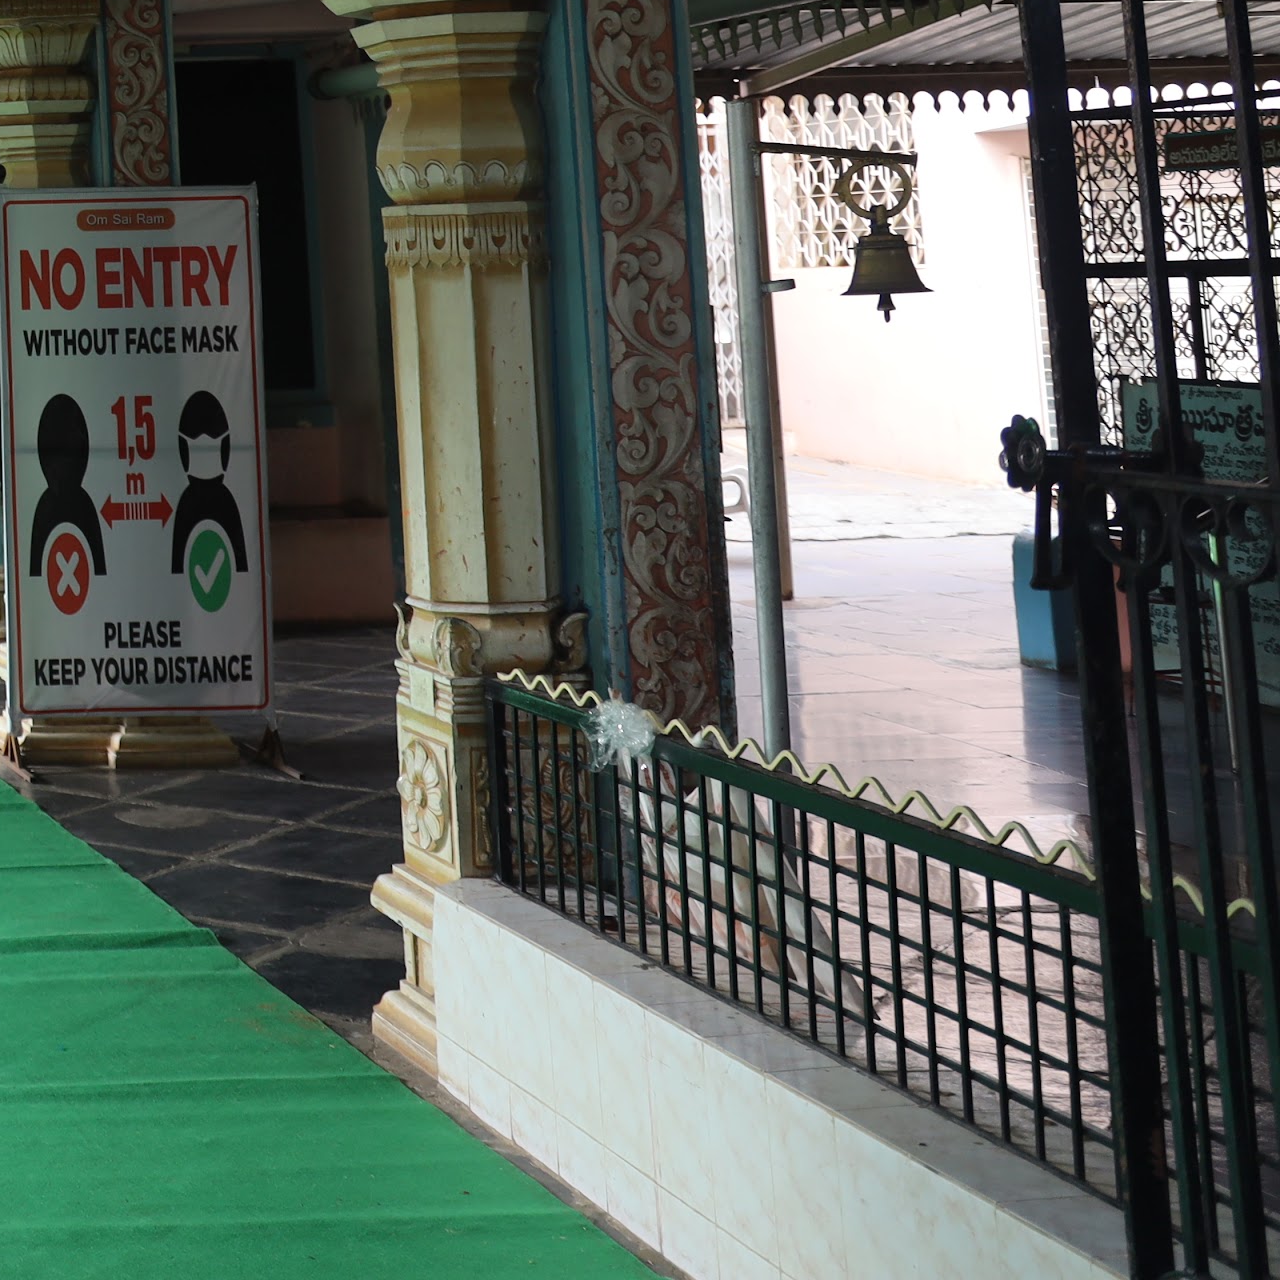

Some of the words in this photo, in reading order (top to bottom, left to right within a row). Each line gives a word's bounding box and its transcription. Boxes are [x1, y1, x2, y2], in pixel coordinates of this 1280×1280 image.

[86, 215, 108, 225] Om
[112, 214, 132, 225] Sai
[136, 213, 165, 224] Ram
[19, 248, 86, 311] NO
[95, 245, 238, 309] ENTRY
[23, 328, 120, 357] WITHOUT
[125, 326, 177, 354] FACE
[181, 324, 240, 354] MASK
[111, 395, 156, 466] 1,5
[126, 472, 145, 495] m
[104, 621, 182, 649] PLEASE
[34, 659, 86, 686] KEEP
[91, 657, 148, 685] YOUR
[154, 654, 253, 684] DISTANCE
